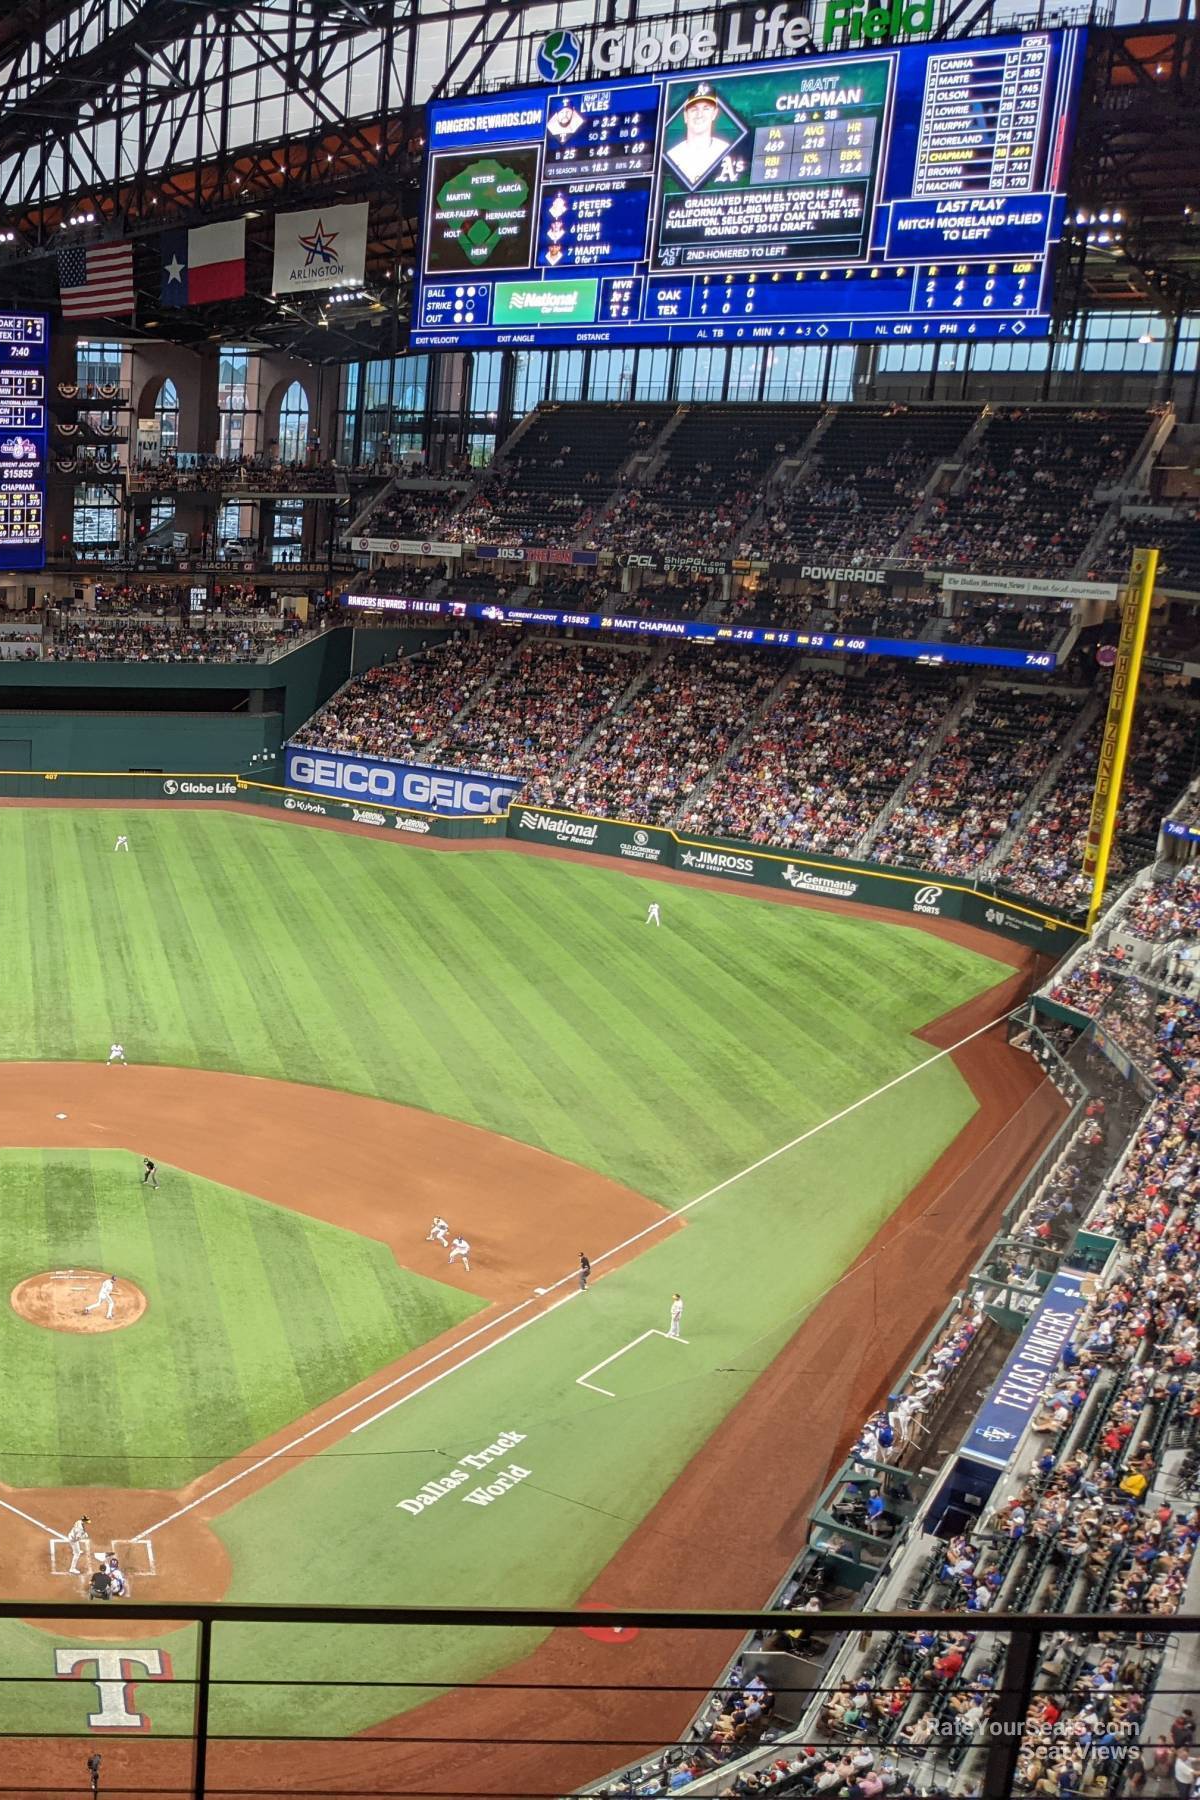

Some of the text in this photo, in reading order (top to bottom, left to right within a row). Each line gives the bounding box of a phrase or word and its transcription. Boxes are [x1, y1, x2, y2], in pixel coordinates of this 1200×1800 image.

[592, 0, 932, 71] Globe Life Field
[940, 59, 974, 70] CANHA
[800, 76, 839, 92] MATT
[939, 75, 970, 85] MARTE
[775, 89, 861, 110] CHAPMAN
[937, 90, 968, 100] OLSON
[580, 101, 609, 113] LYLES
[934, 106, 969, 116] LOWRIE
[933, 120, 971, 131] MURPHY
[931, 135, 982, 146] MORELAND
[929, 150, 973, 162] CHAPMAN
[927, 166, 962, 176] BROWN
[471, 176, 495, 184] PETERS
[446, 193, 470, 201] MARTIN
[685, 192, 814, 209] GRADUATED FROM TORO
[579, 200, 612, 209] PETERS
[727, 198, 859, 216] ALL-BIG WEST STATE
[936, 198, 1006, 213] LAST PLAY
[721, 209, 840, 226] SELECTED THE
[898, 213, 1042, 230] MITCH MORELAND FLIED
[577, 223, 600, 232] HEIM
[704, 223, 778, 236] ROUND 2014
[962, 229, 990, 239] LEFT
[575, 246, 610, 255] MARTIN
[687, 249, 749, 260] 2ND-HOMERED
[289, 265, 344, 280] ARLINGTON
[428, 289, 445, 298] BALL
[658, 290, 681, 301] OAK
[427, 302, 451, 310] STRIKE
[658, 306, 678, 315] TEX
[426, 315, 442, 323] OUT
[430, 336, 459, 344] VELOCITY
[577, 333, 610, 342] DISTANCE
[10, 347, 29, 356] 7:40
[3, 470, 33, 479] $15855
[497, 547, 524, 559] 105.3
[627, 555, 657, 567] PGL
[664, 556, 726, 567] ShipPGL.com
[800, 567, 886, 583] POWERADE
[348, 596, 406, 610] RANGERS REWARDS
[508, 611, 532, 619] CURRENT
[533, 613, 557, 621] JACKPOT
[562, 615, 589, 625] $15855
[601, 618, 1049, 665] 26 MATT CHAPMAN .218 53 400 7:40
[1098, 724, 1117, 793] ZONE
[180, 782, 236, 794] Globe Life
[290, 756, 396, 798] GEICO
[403, 772, 515, 816] GEICO
[296, 799, 326, 815] Kubota
[536, 818, 596, 839] National
[557, 833, 594, 845] Car Rental
[621, 849, 645, 858] FREIGHT
[632, 845, 660, 855] DOMINION
[803, 873, 857, 891] Germania
[913, 904, 940, 915] SPORTS
[994, 1308, 1075, 1410] TEXAS RANGERS
[396, 1428, 528, 1516] Dallas Truck
[461, 1464, 532, 1508] World
[53, 1648, 173, 1733] T
